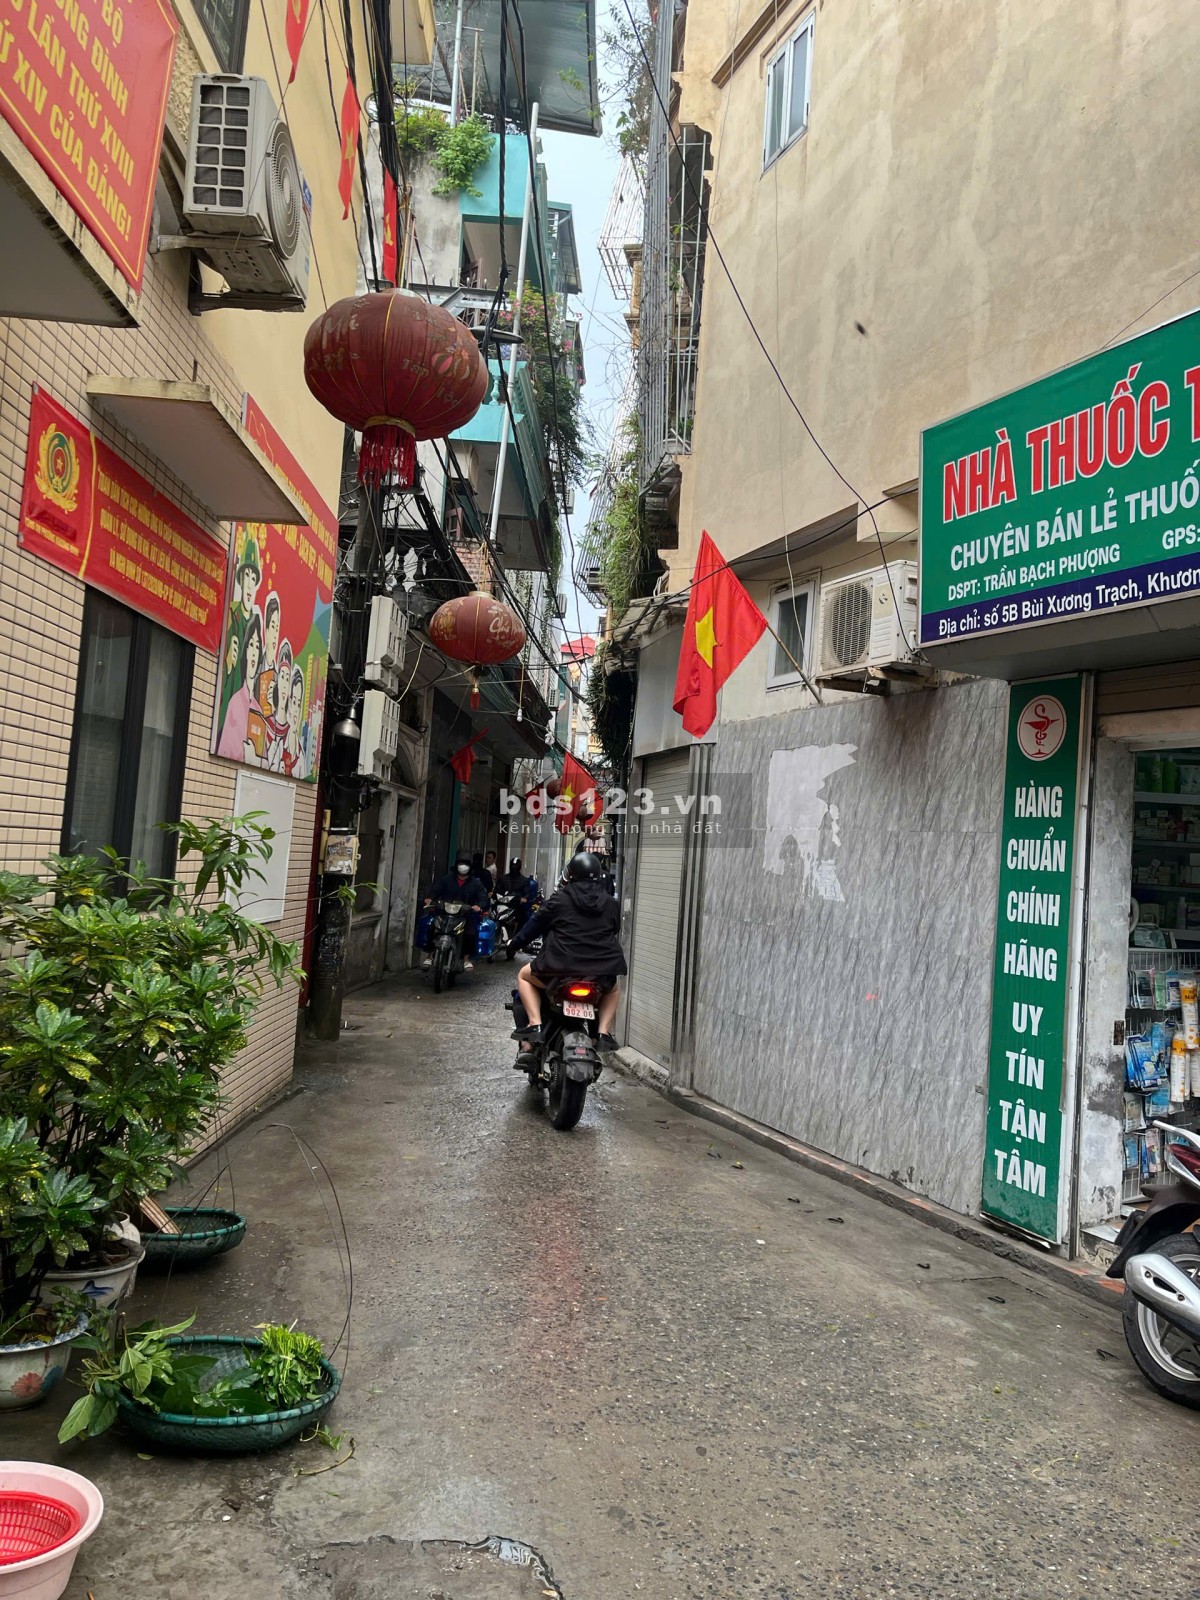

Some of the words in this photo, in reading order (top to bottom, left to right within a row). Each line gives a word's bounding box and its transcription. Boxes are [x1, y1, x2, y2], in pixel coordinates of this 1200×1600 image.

[27, 0, 66, 79] LẦN
[69, 61, 103, 129] THỨ
[101, 115, 134, 187] XVIII
[91, 36, 129, 117] ĐÌNH
[12, 48, 49, 116] XIV
[50, 104, 84, 174] CỦA
[86, 156, 132, 242] ĐẢNG!
[943, 428, 1017, 524] NHÀ
[1026, 362, 1170, 495] THUỐC
[950, 522, 1030, 571] CHUYÊN
[1036, 507, 1083, 549] BÁN
[1090, 487, 1117, 534] LẺ
[1162, 523, 1200, 550] GPS:
[948, 579, 981, 601] DSPT:
[984, 564, 1016, 593] TRẦN
[1019, 560, 1056, 587] BẠCH
[1059, 543, 1120, 574] PHƯỢNG
[939, 617, 957, 638] Địa
[959, 608, 981, 631] chỉ:
[984, 603, 1000, 627] số
[1002, 604, 1018, 623] 5B
[1021, 597, 1043, 620] Bùi
[1047, 591, 1092, 615] Xương
[1096, 578, 1143, 607] Trạch,
[1014, 779, 1063, 818] HÀNG
[1006, 826, 1067, 873] CHUẨN
[1006, 885, 1061, 927] CHÍNH
[1003, 938, 1058, 982] HÃNG
[1012, 1001, 1044, 1037] UY
[1005, 1048, 1045, 1091] TÍN
[999, 1098, 1047, 1144] TẬN
[994, 1149, 1047, 1198] TÂM
